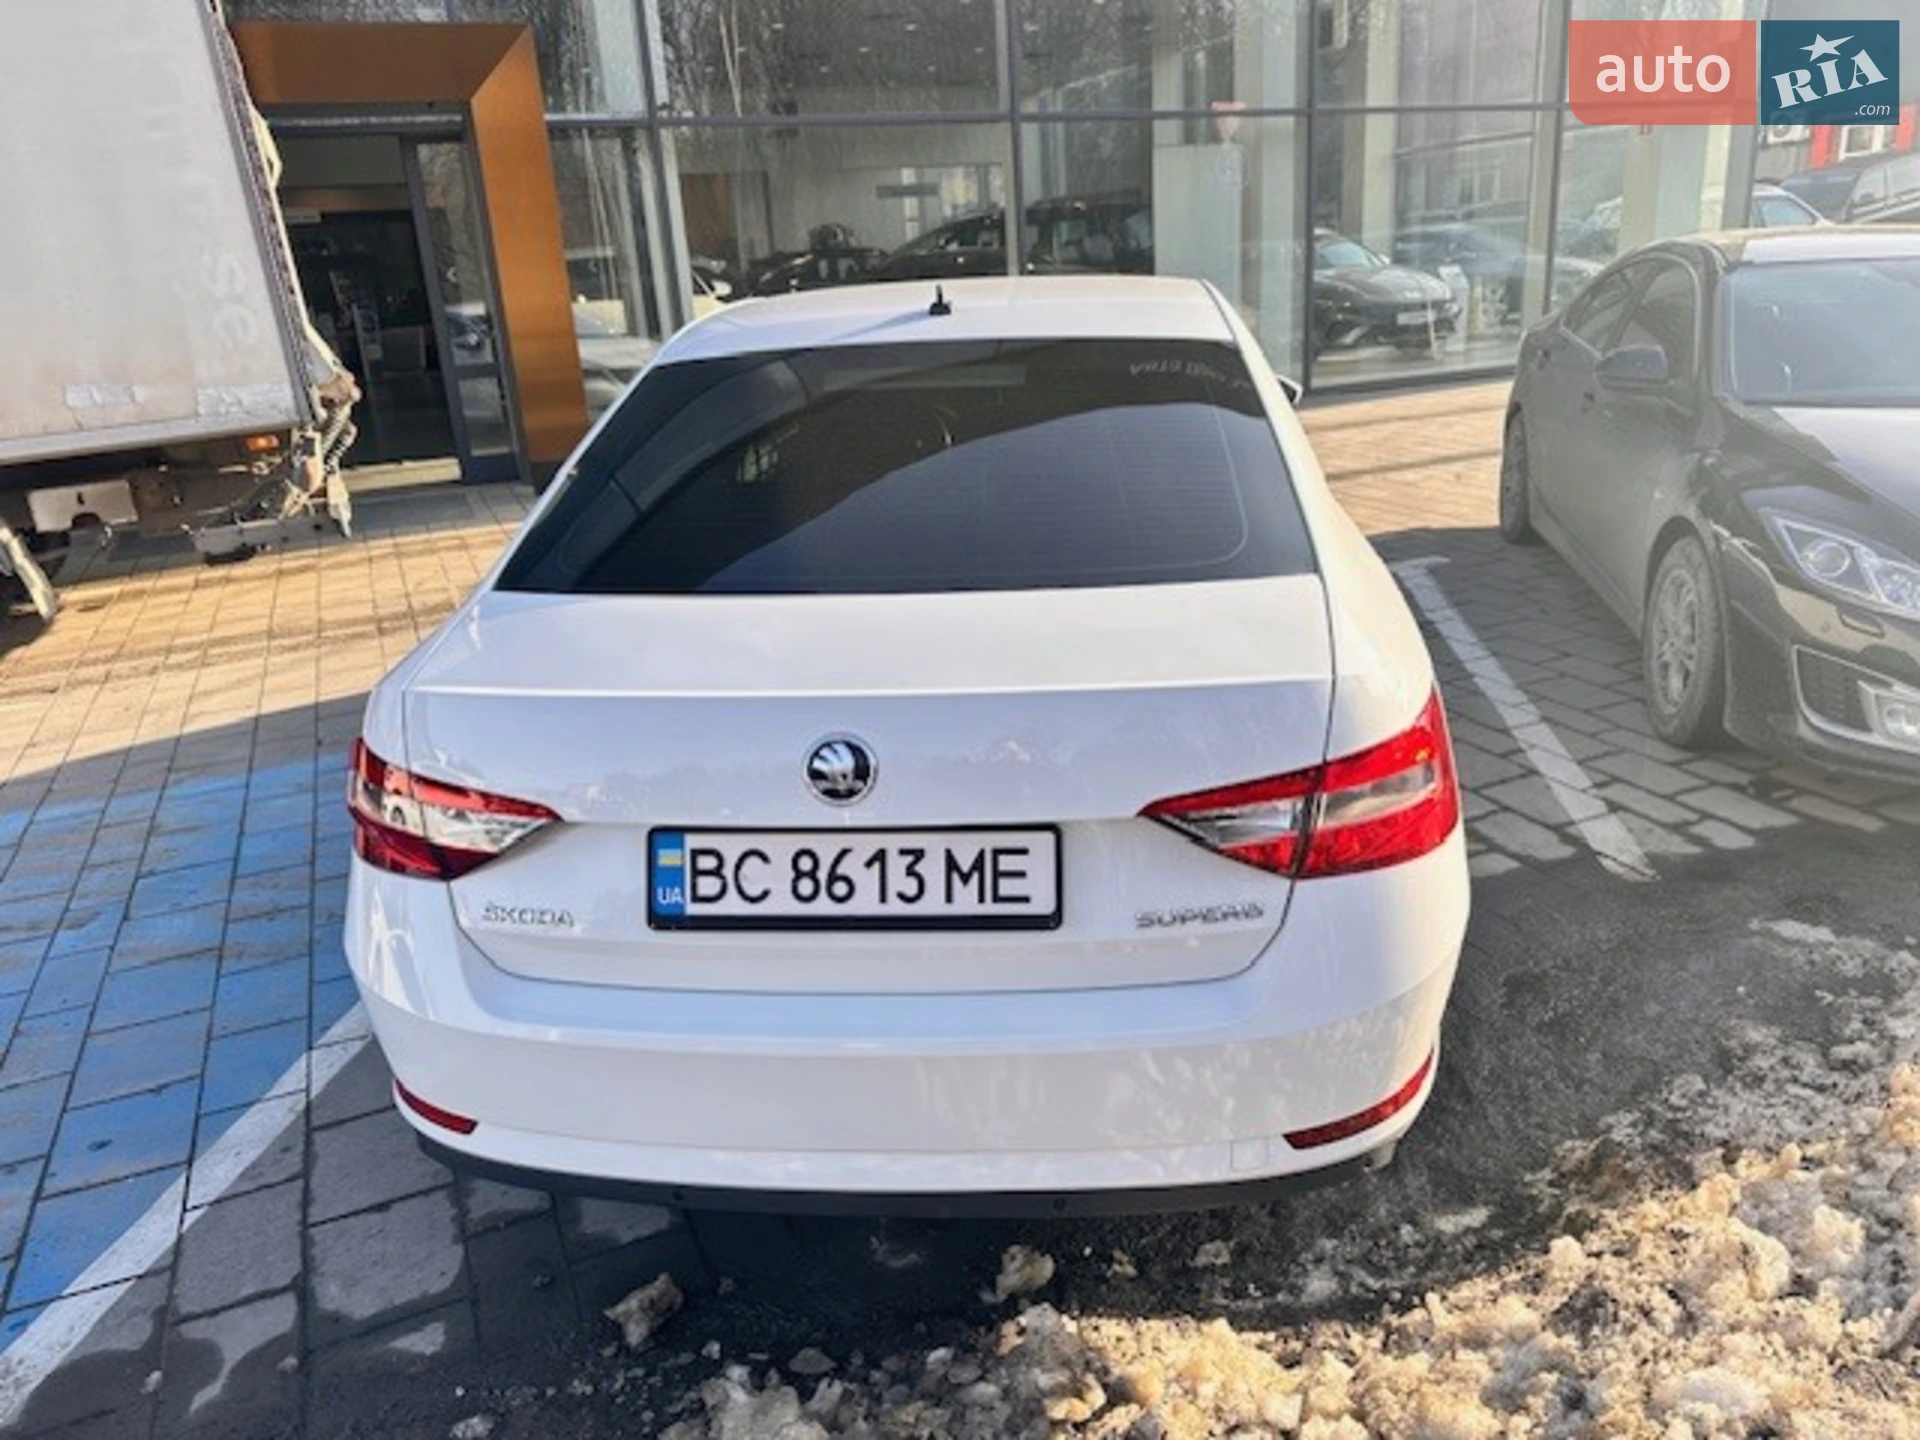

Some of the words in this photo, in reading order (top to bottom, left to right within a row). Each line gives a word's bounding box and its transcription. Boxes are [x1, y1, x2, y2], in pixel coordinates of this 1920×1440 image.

[689, 848, 772, 904] BC
[790, 847, 927, 904] 8613
[943, 847, 1031, 904] ME
[656, 887, 684, 904] UA
[1134, 903, 1265, 928] SUPERB
